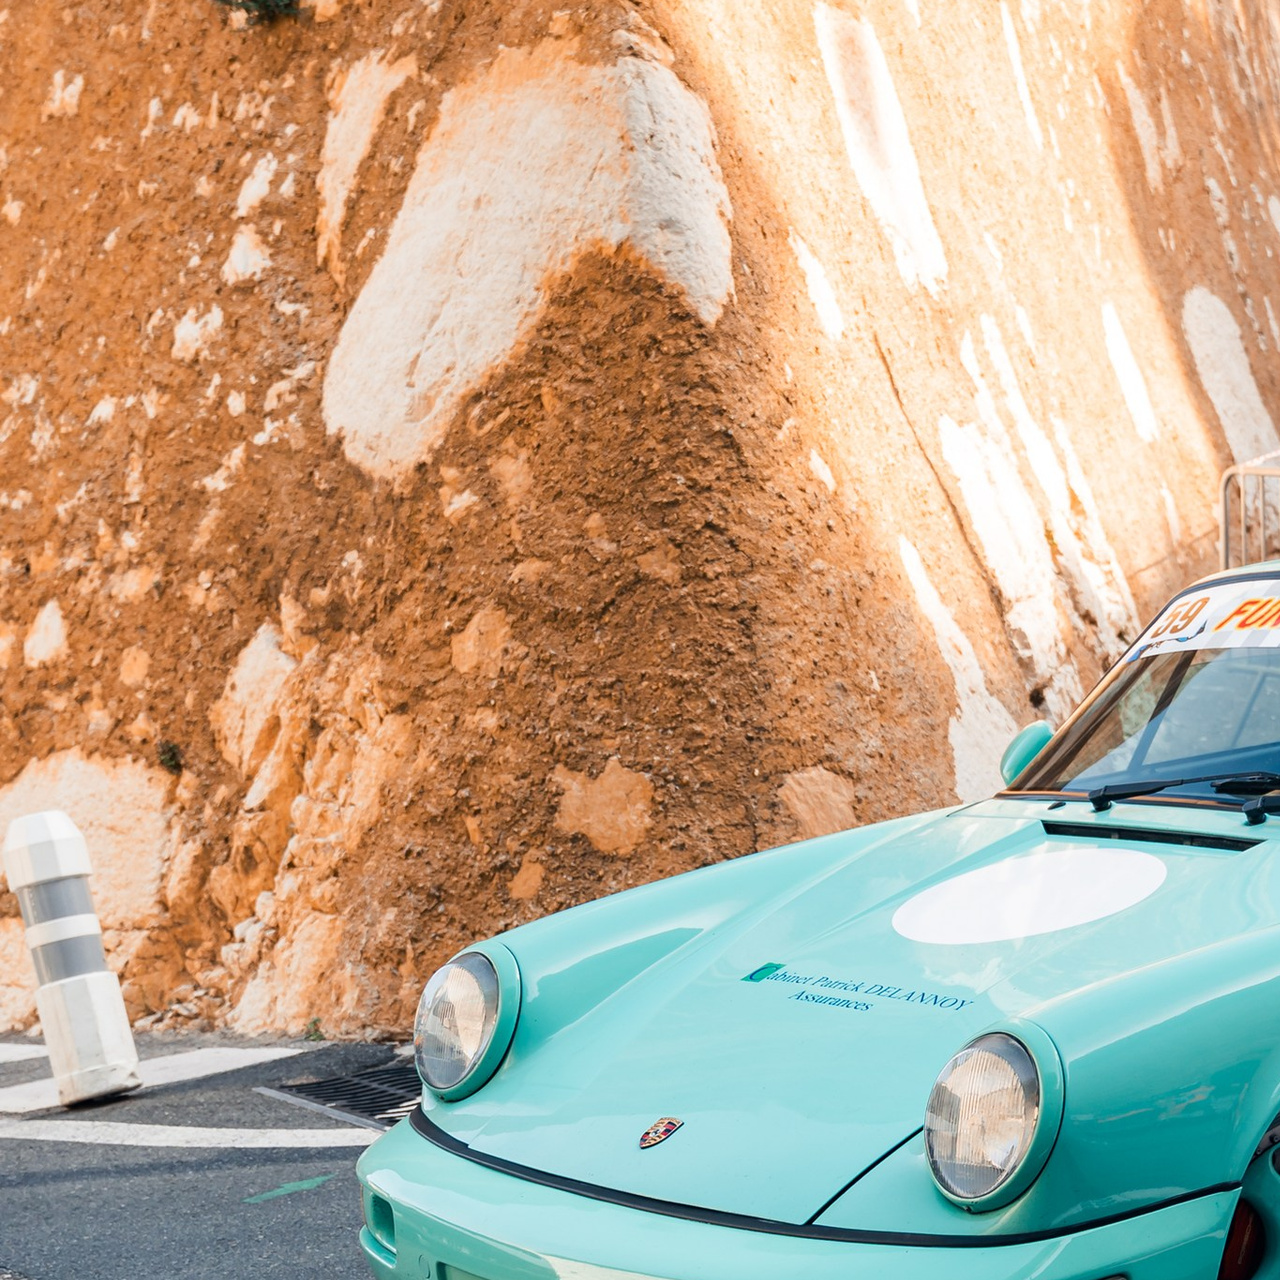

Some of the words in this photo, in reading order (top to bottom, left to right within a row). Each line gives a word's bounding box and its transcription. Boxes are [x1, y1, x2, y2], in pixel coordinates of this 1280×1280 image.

[1151, 597, 1211, 639] 59
[750, 966, 813, 986] Cabinet
[812, 976, 865, 994] Patrick
[864, 984, 974, 1012] DELANNOY
[788, 990, 874, 1012] Assurances
